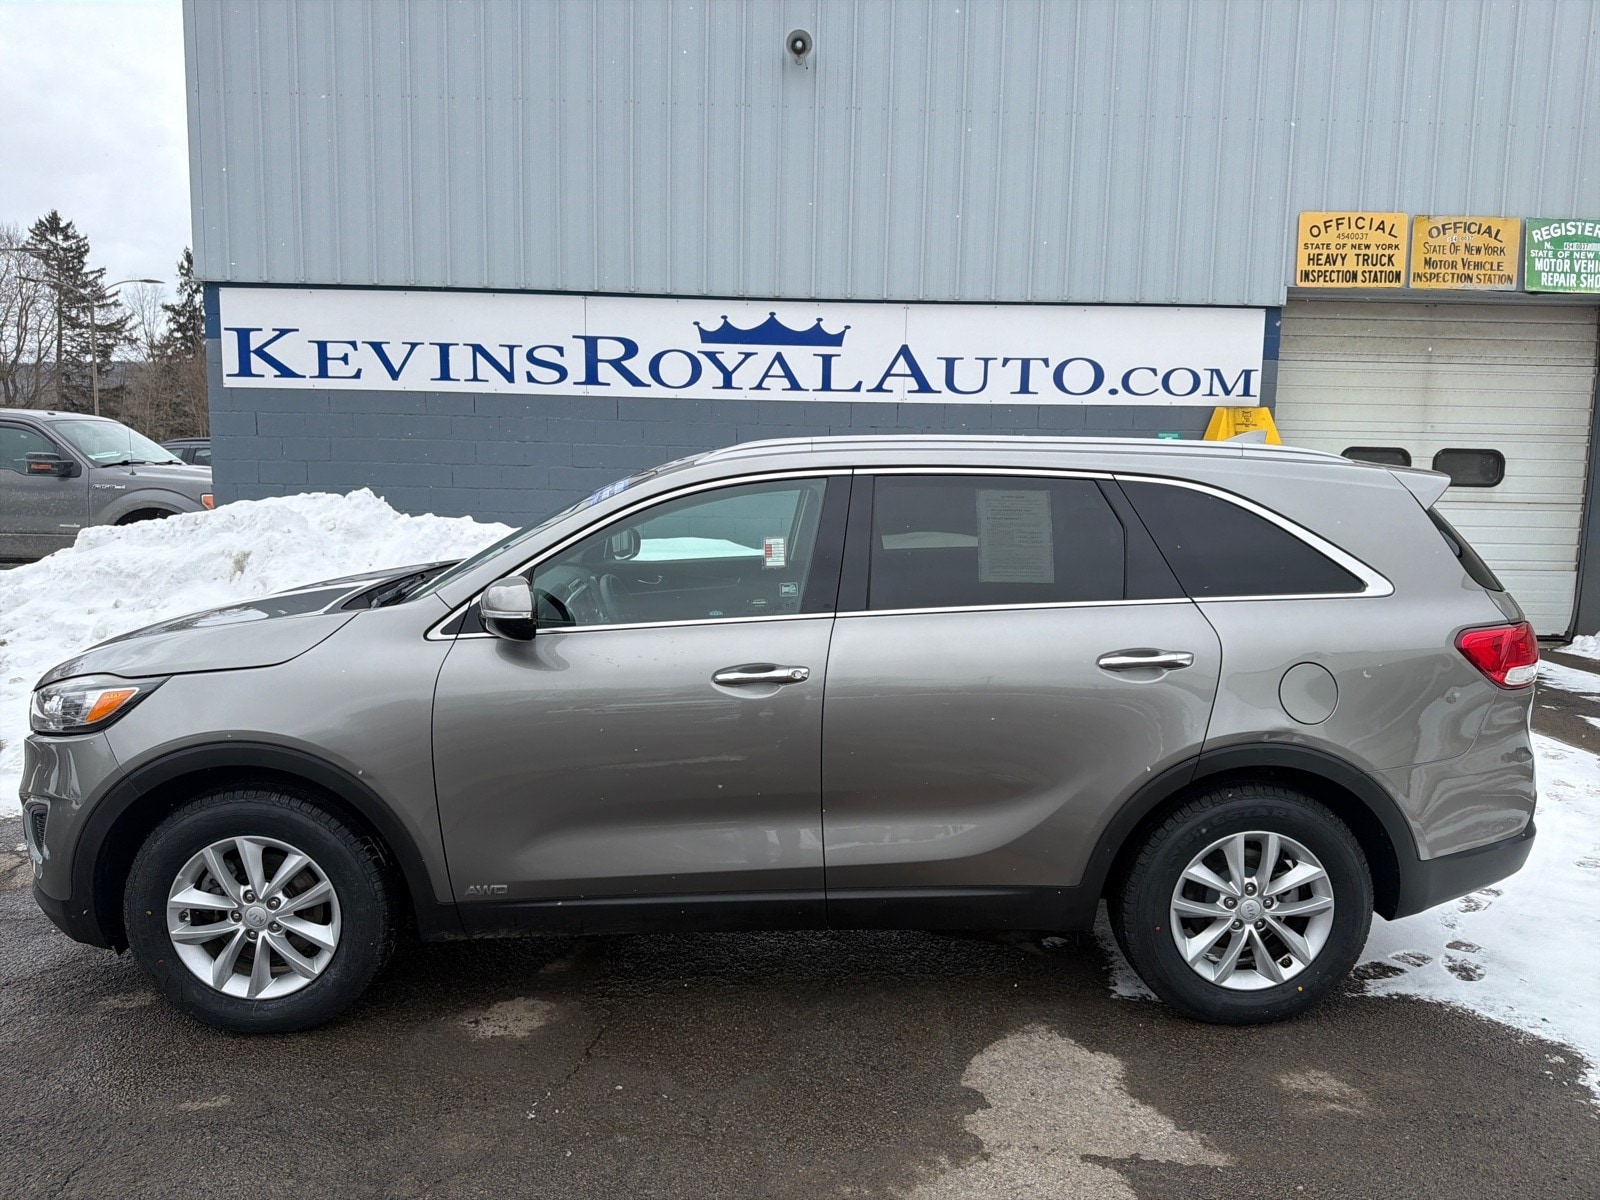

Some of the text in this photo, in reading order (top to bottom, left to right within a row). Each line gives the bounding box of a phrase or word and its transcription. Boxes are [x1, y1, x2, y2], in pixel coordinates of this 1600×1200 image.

[1309, 216, 1398, 239] OFFICIAL
[1427, 221, 1504, 243] OFFICIAL
[1336, 232, 1369, 240] 4540037
[1303, 242, 1332, 250] STATE
[1375, 243, 1400, 251] YORK
[1423, 241, 1506, 256] STATE OF NEW YORK
[1530, 249, 1595, 259] STATE OF NEW
[1307, 253, 1396, 267] HEAVY TRUCK
[1423, 256, 1505, 272] MOTOR VEHICLE
[1535, 258, 1600, 273] MOTOR VEHI
[1300, 269, 1402, 284] INSPECTION STATION
[1412, 271, 1513, 285] INSPECTION STATION
[1541, 272, 1577, 287] REPAIR
[464, 884, 508, 896] AWD
